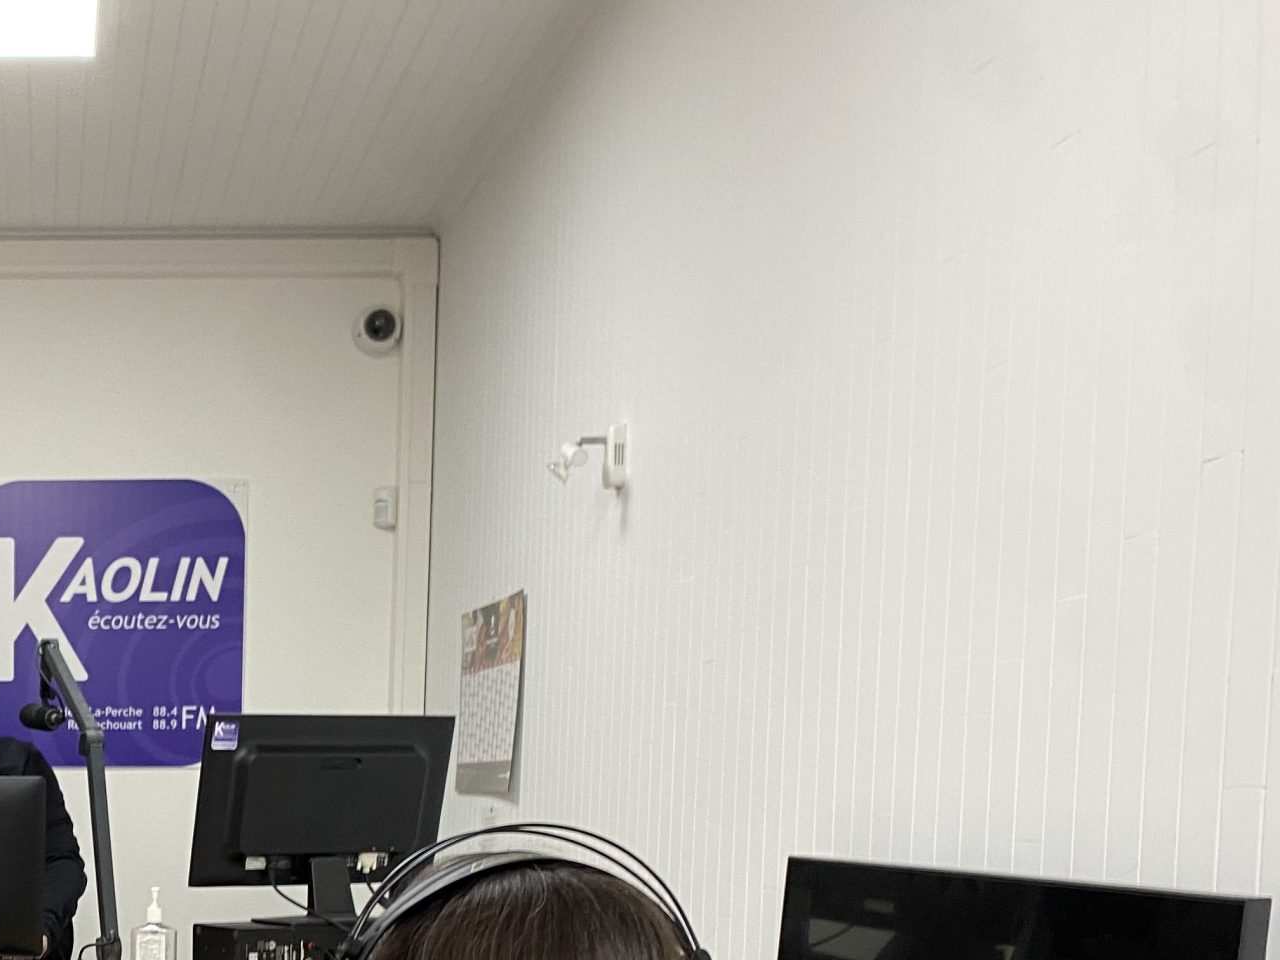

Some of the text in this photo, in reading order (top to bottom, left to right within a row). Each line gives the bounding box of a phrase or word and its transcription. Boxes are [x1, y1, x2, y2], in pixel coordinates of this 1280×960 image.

[87, 609, 220, 630] écoutez-vous
[152, 705, 178, 718] 88.4
[152, 719, 178, 731] 88.9
